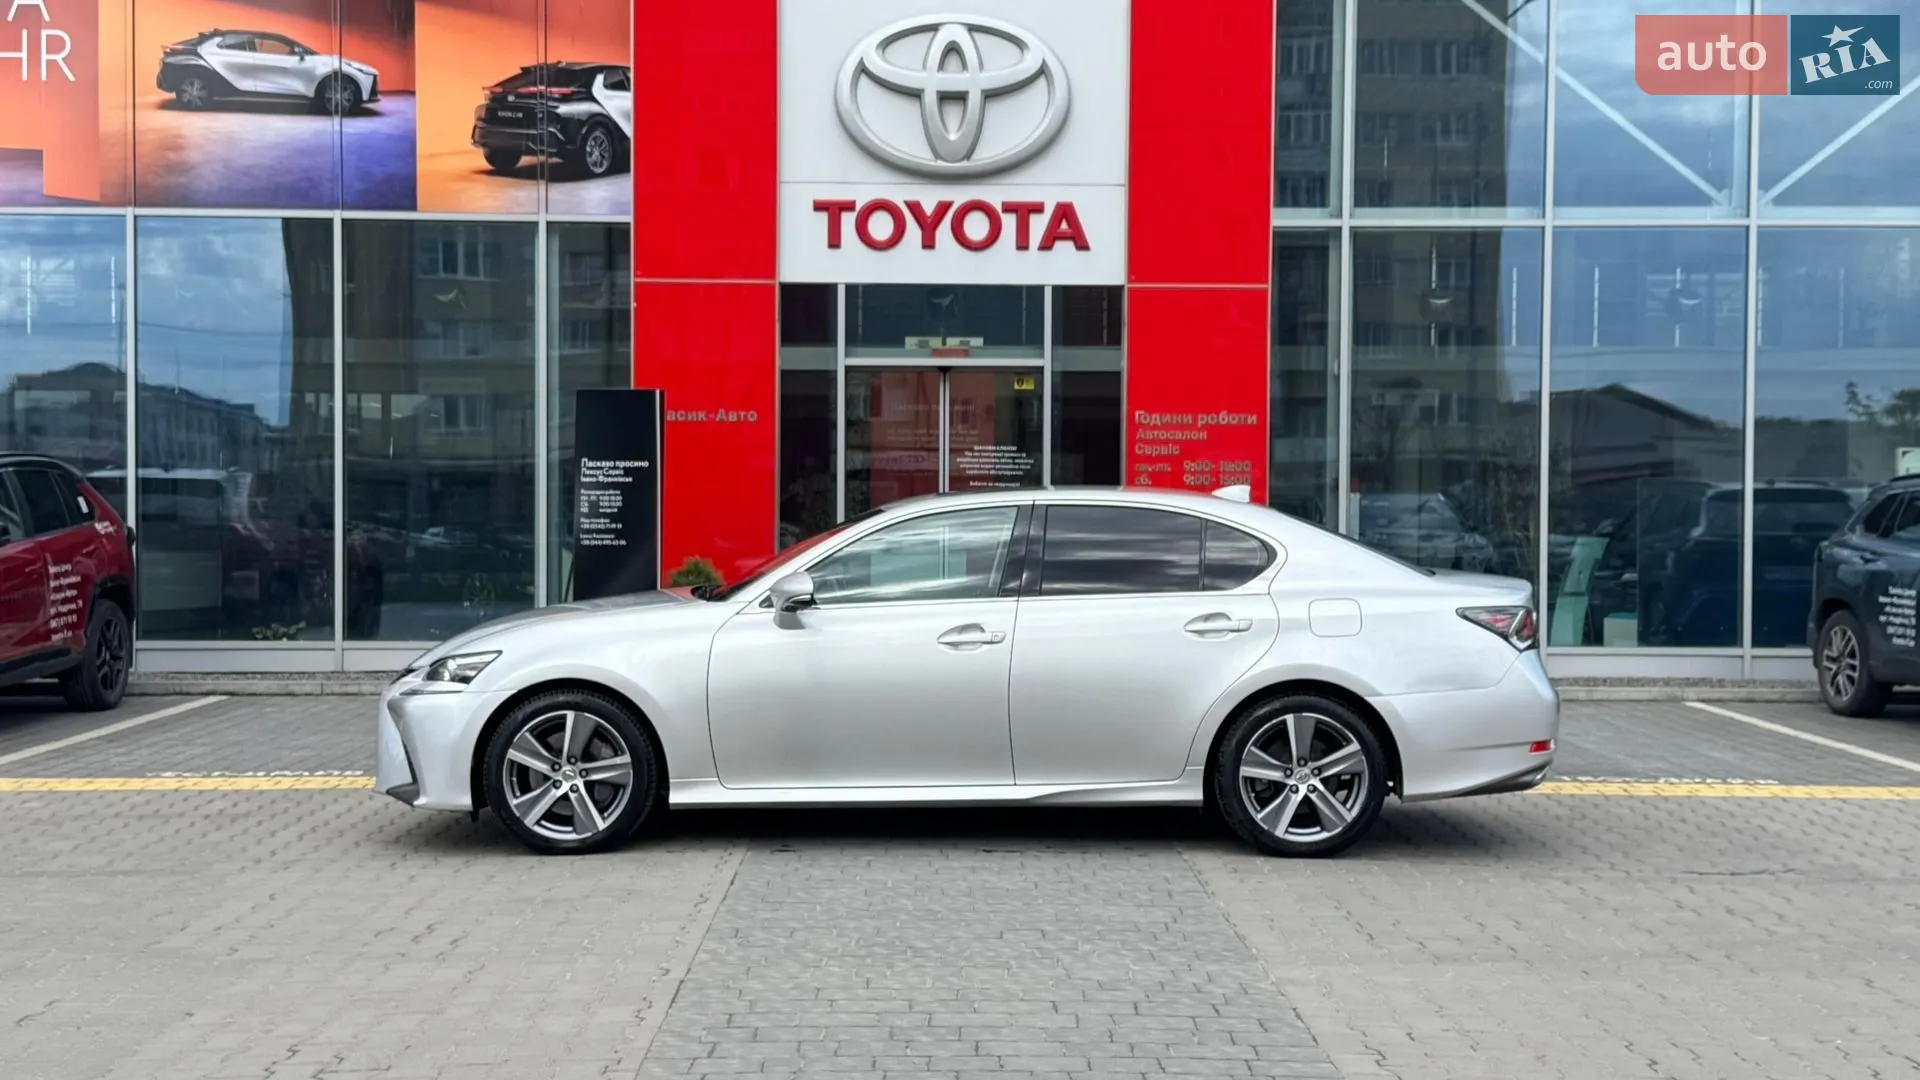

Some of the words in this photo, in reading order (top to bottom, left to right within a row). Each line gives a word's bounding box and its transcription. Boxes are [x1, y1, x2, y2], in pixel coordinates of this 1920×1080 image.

[813, 198, 1091, 252] TOYOTA
[1135, 410, 1193, 426] Години
[1197, 411, 1258, 428] роботи
[1136, 428, 1207, 440] Автосалон
[1135, 443, 1180, 457] Сервіс
